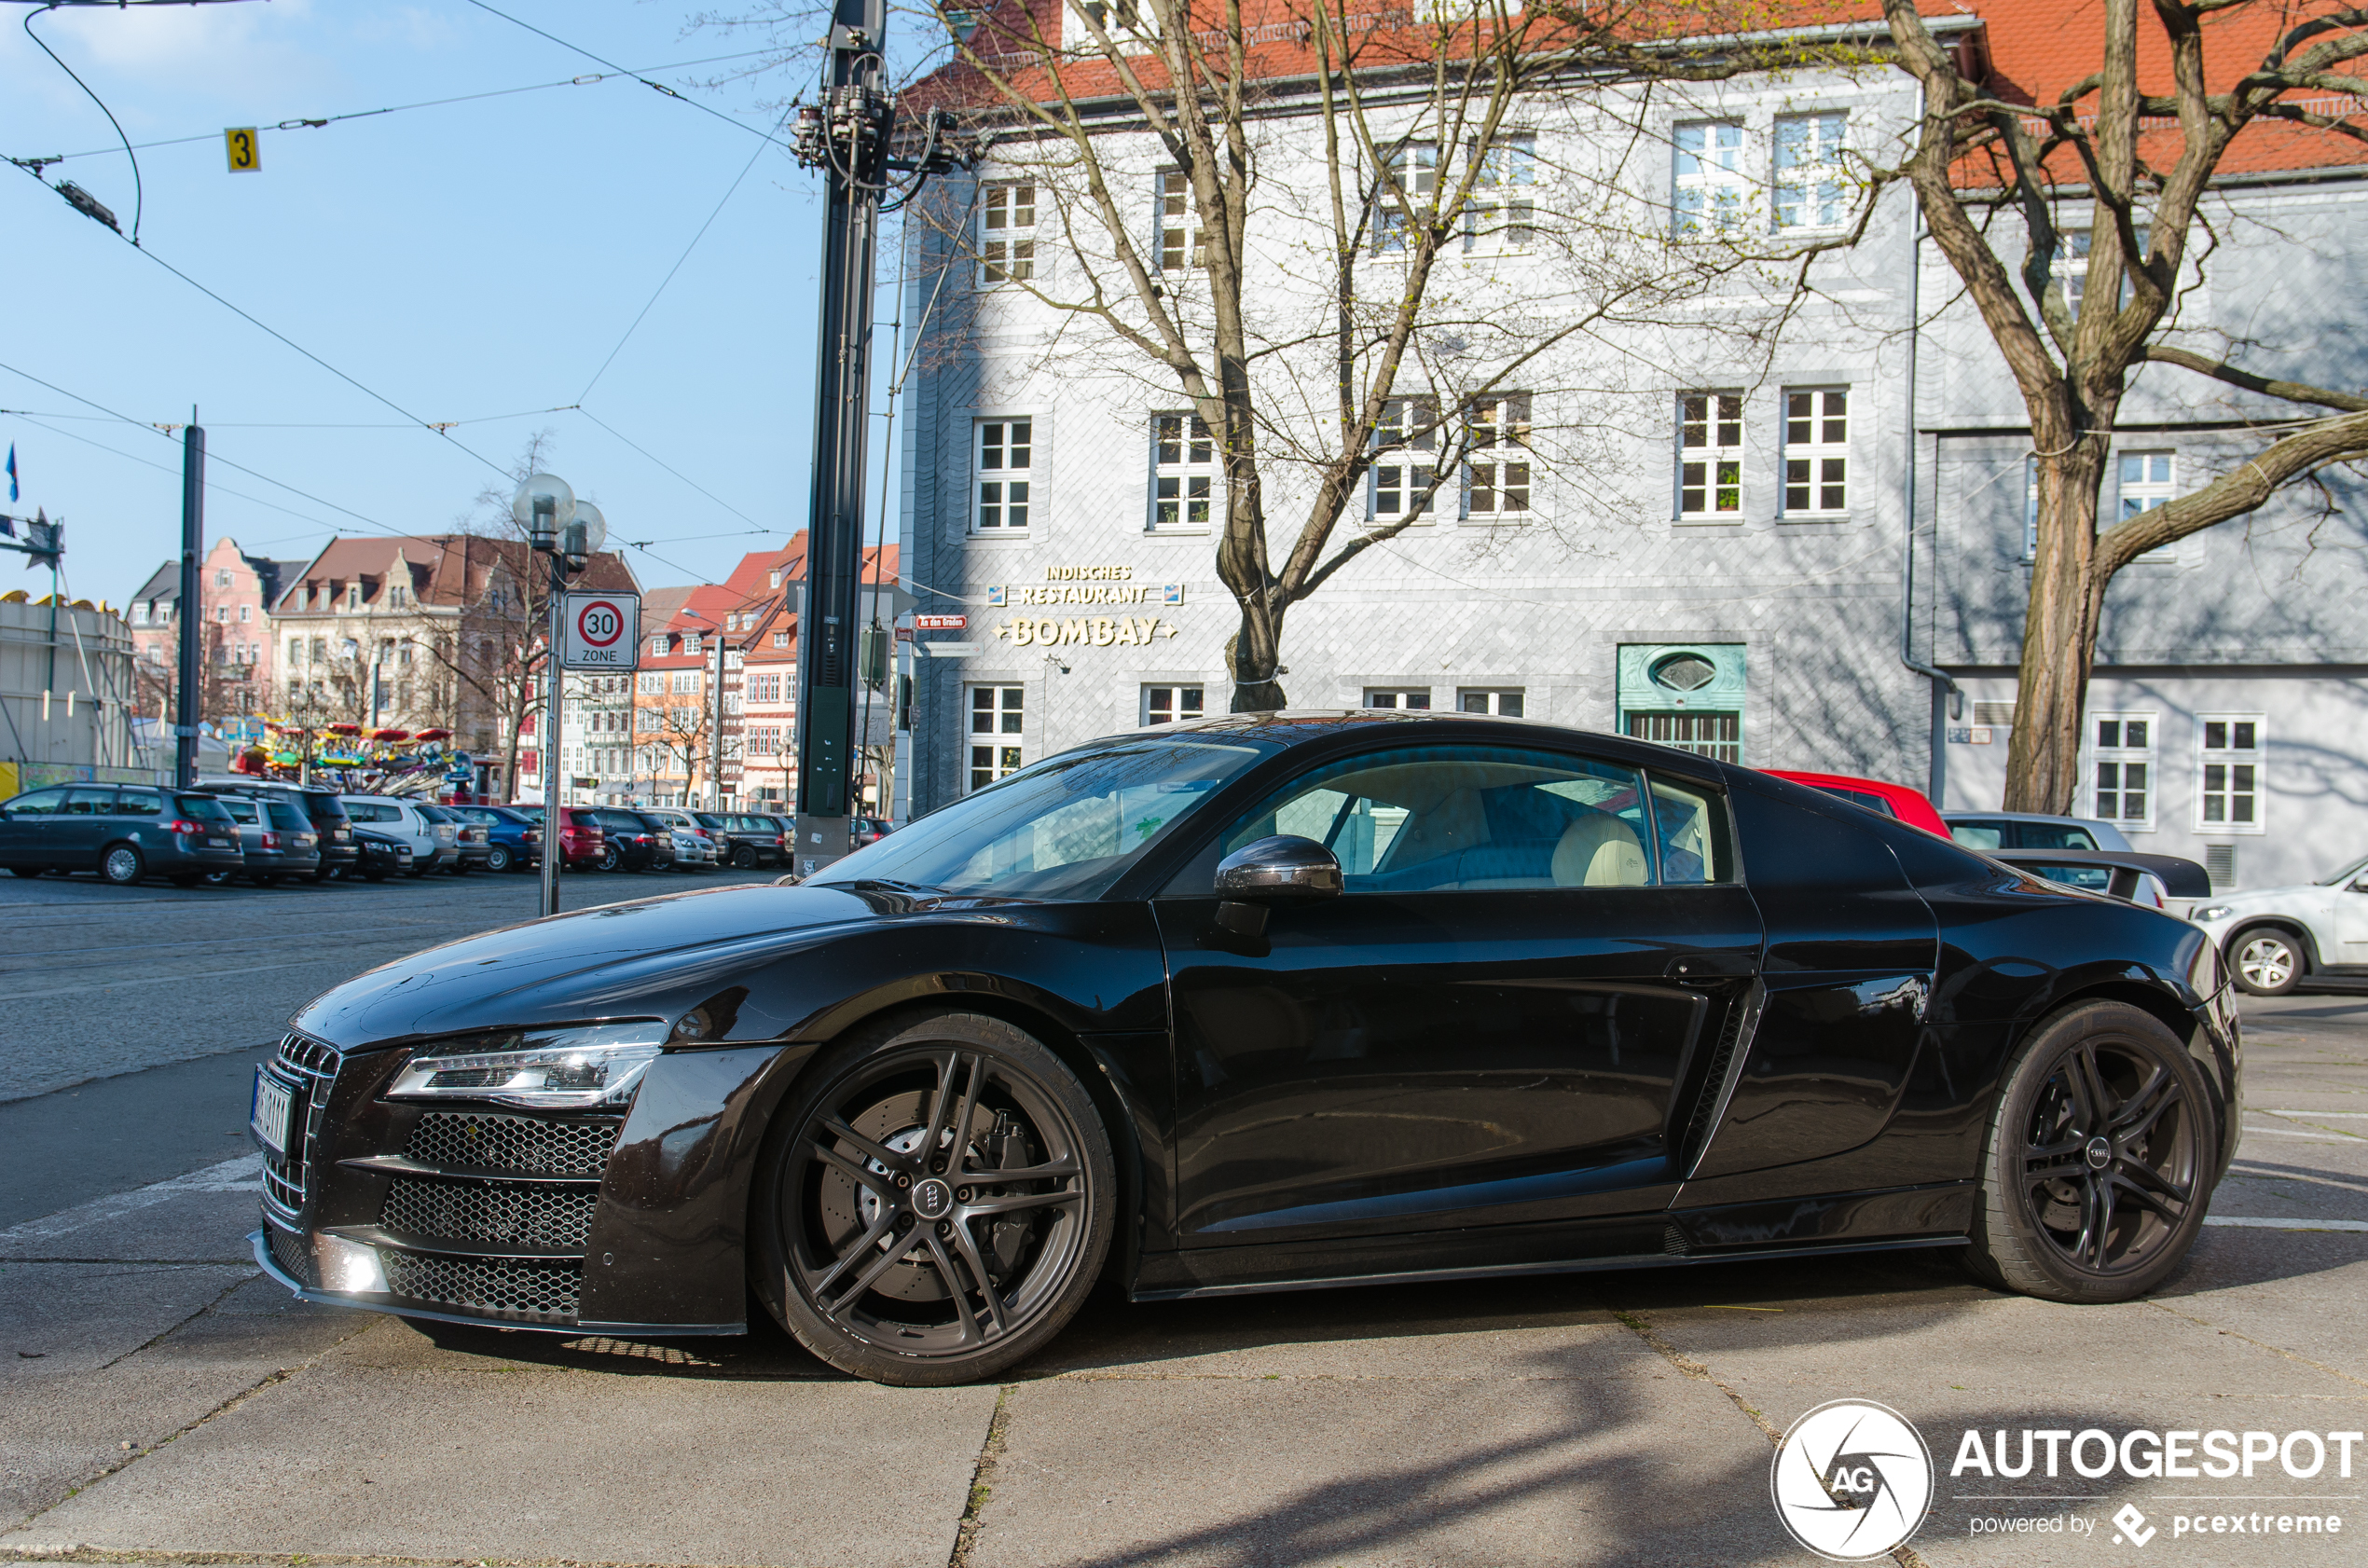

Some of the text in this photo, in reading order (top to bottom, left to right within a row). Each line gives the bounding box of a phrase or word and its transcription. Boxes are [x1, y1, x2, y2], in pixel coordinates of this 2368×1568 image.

[234, 132, 252, 168] 3
[1044, 565, 1133, 581] INDISCHES
[1019, 584, 1149, 605] RESTAURANT
[586, 612, 614, 635] 30
[919, 617, 963, 627] An den Graden
[1009, 615, 1162, 647] BOMBAY
[582, 650, 617, 662] ZONE
